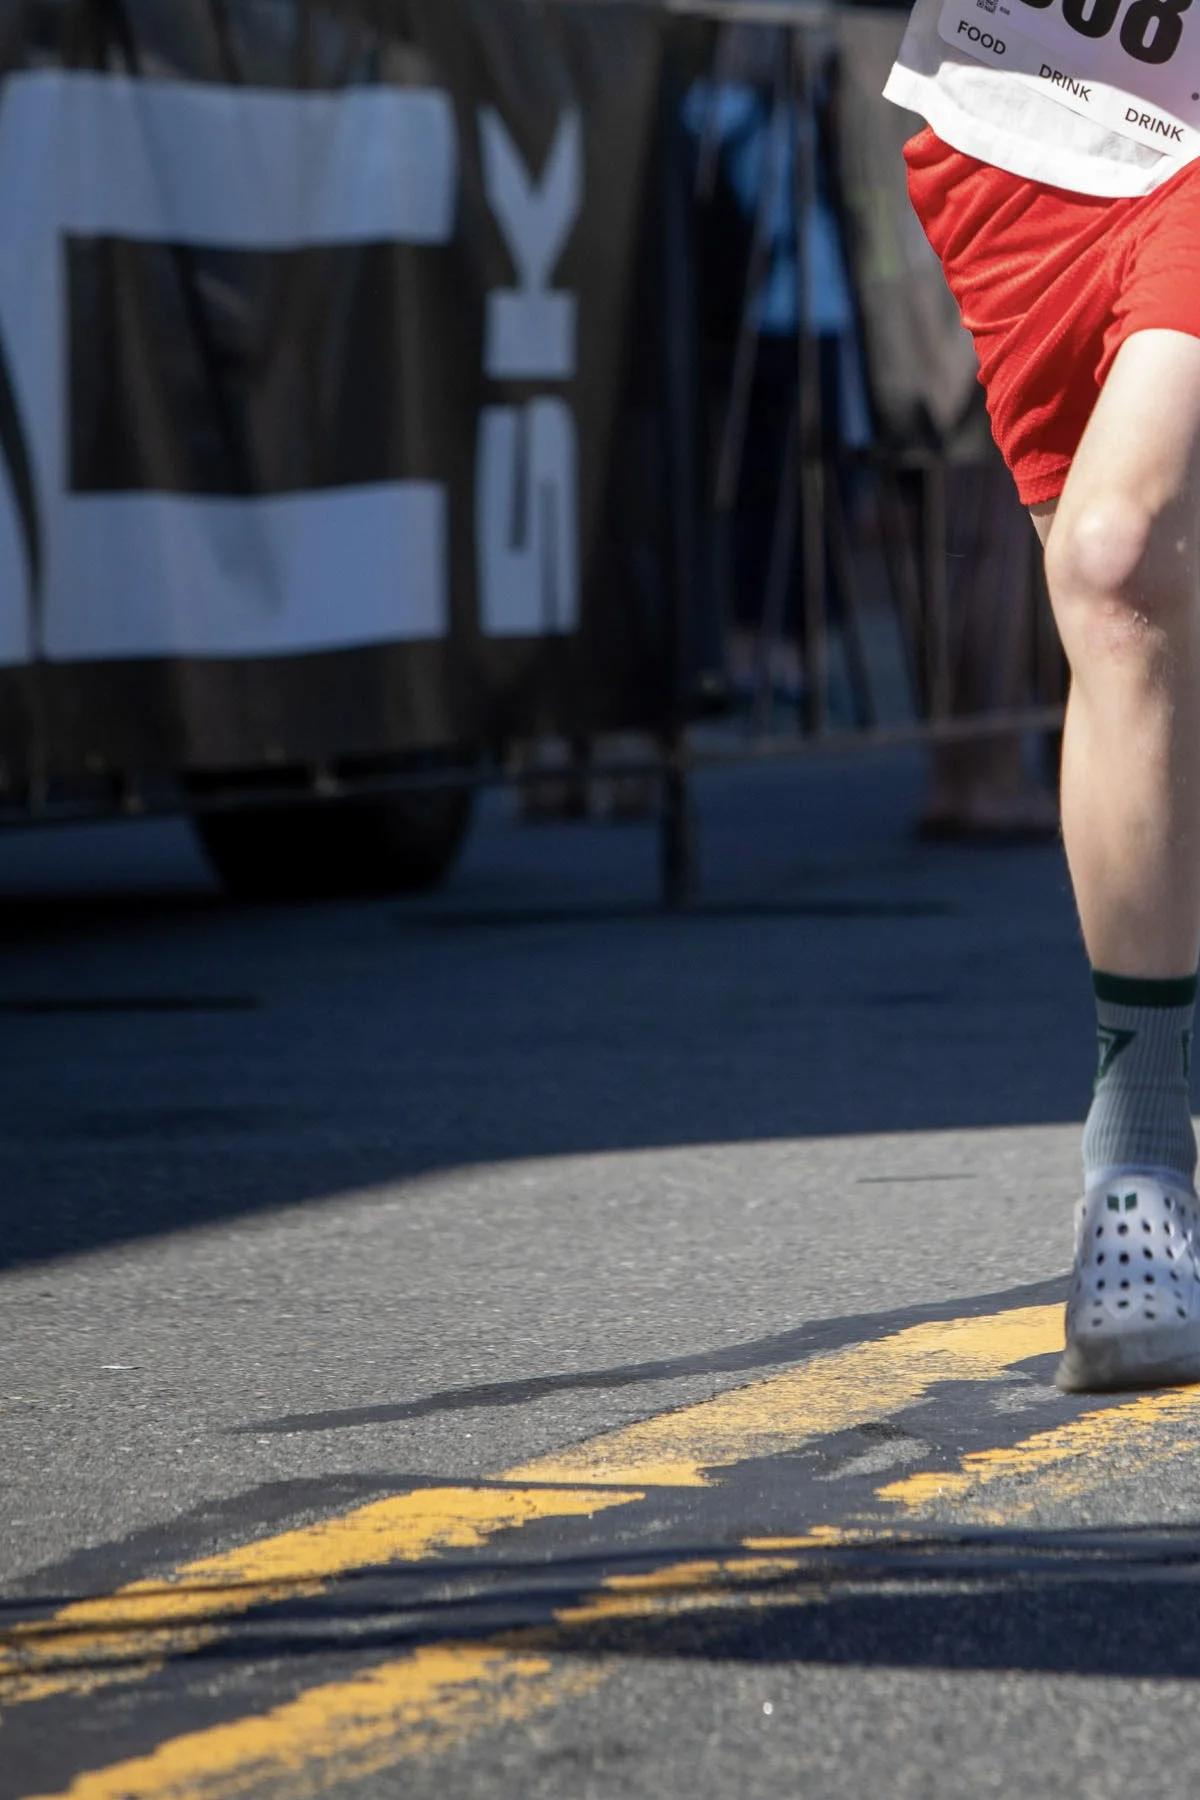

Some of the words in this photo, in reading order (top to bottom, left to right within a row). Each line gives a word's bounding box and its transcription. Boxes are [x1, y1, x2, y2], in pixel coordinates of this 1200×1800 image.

[957, 20, 1007, 56] FOOD
[1038, 63, 1093, 102] DRINK
[1124, 107, 1185, 142] DRINK
